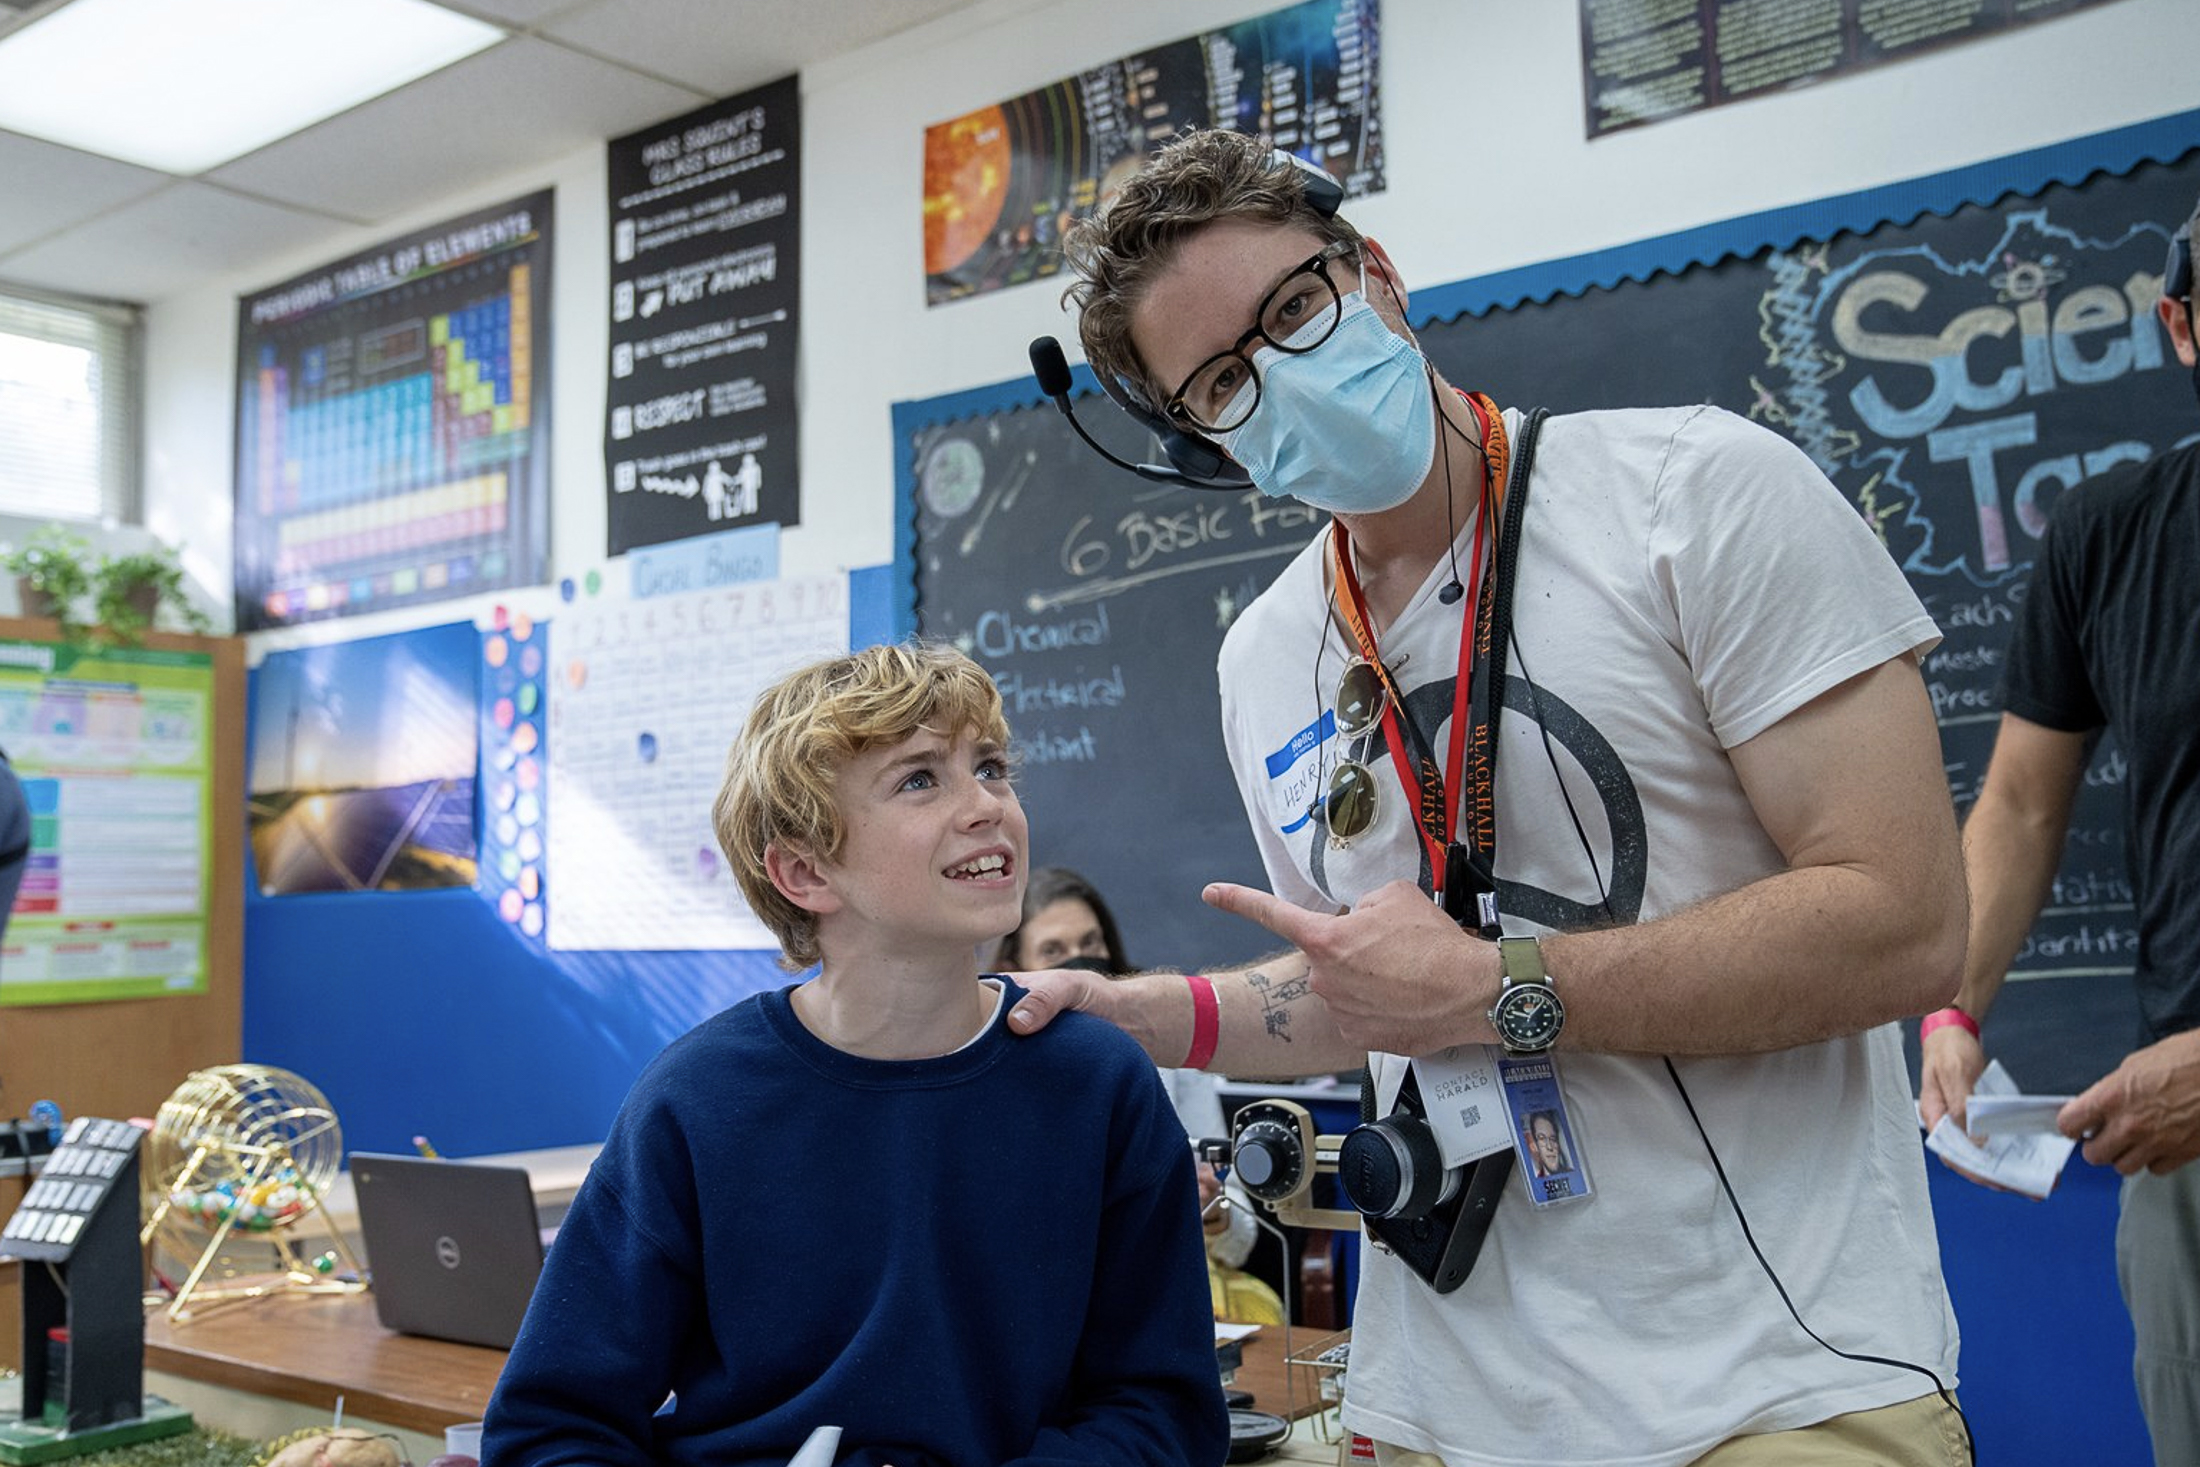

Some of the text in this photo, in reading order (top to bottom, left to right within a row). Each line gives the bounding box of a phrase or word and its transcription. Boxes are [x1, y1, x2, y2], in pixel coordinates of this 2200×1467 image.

[650, 131, 761, 185] CLASS RULES
[334, 255, 392, 296] TABLE
[393, 246, 421, 277] OF
[424, 211, 531, 266] ELEMENTS
[634, 389, 706, 430] RESPECT
[705, 541, 762, 586] BINGO
[1060, 514, 1111, 576] 6
[1116, 504, 1233, 570] Basic
[975, 602, 1111, 658] Chemical
[1291, 730, 1315, 753] Hello
[1473, 723, 1494, 854] BLACKHALL
[1434, 1068, 1485, 1093] CONTACT
[1436, 1077, 1489, 1102] HARALD
